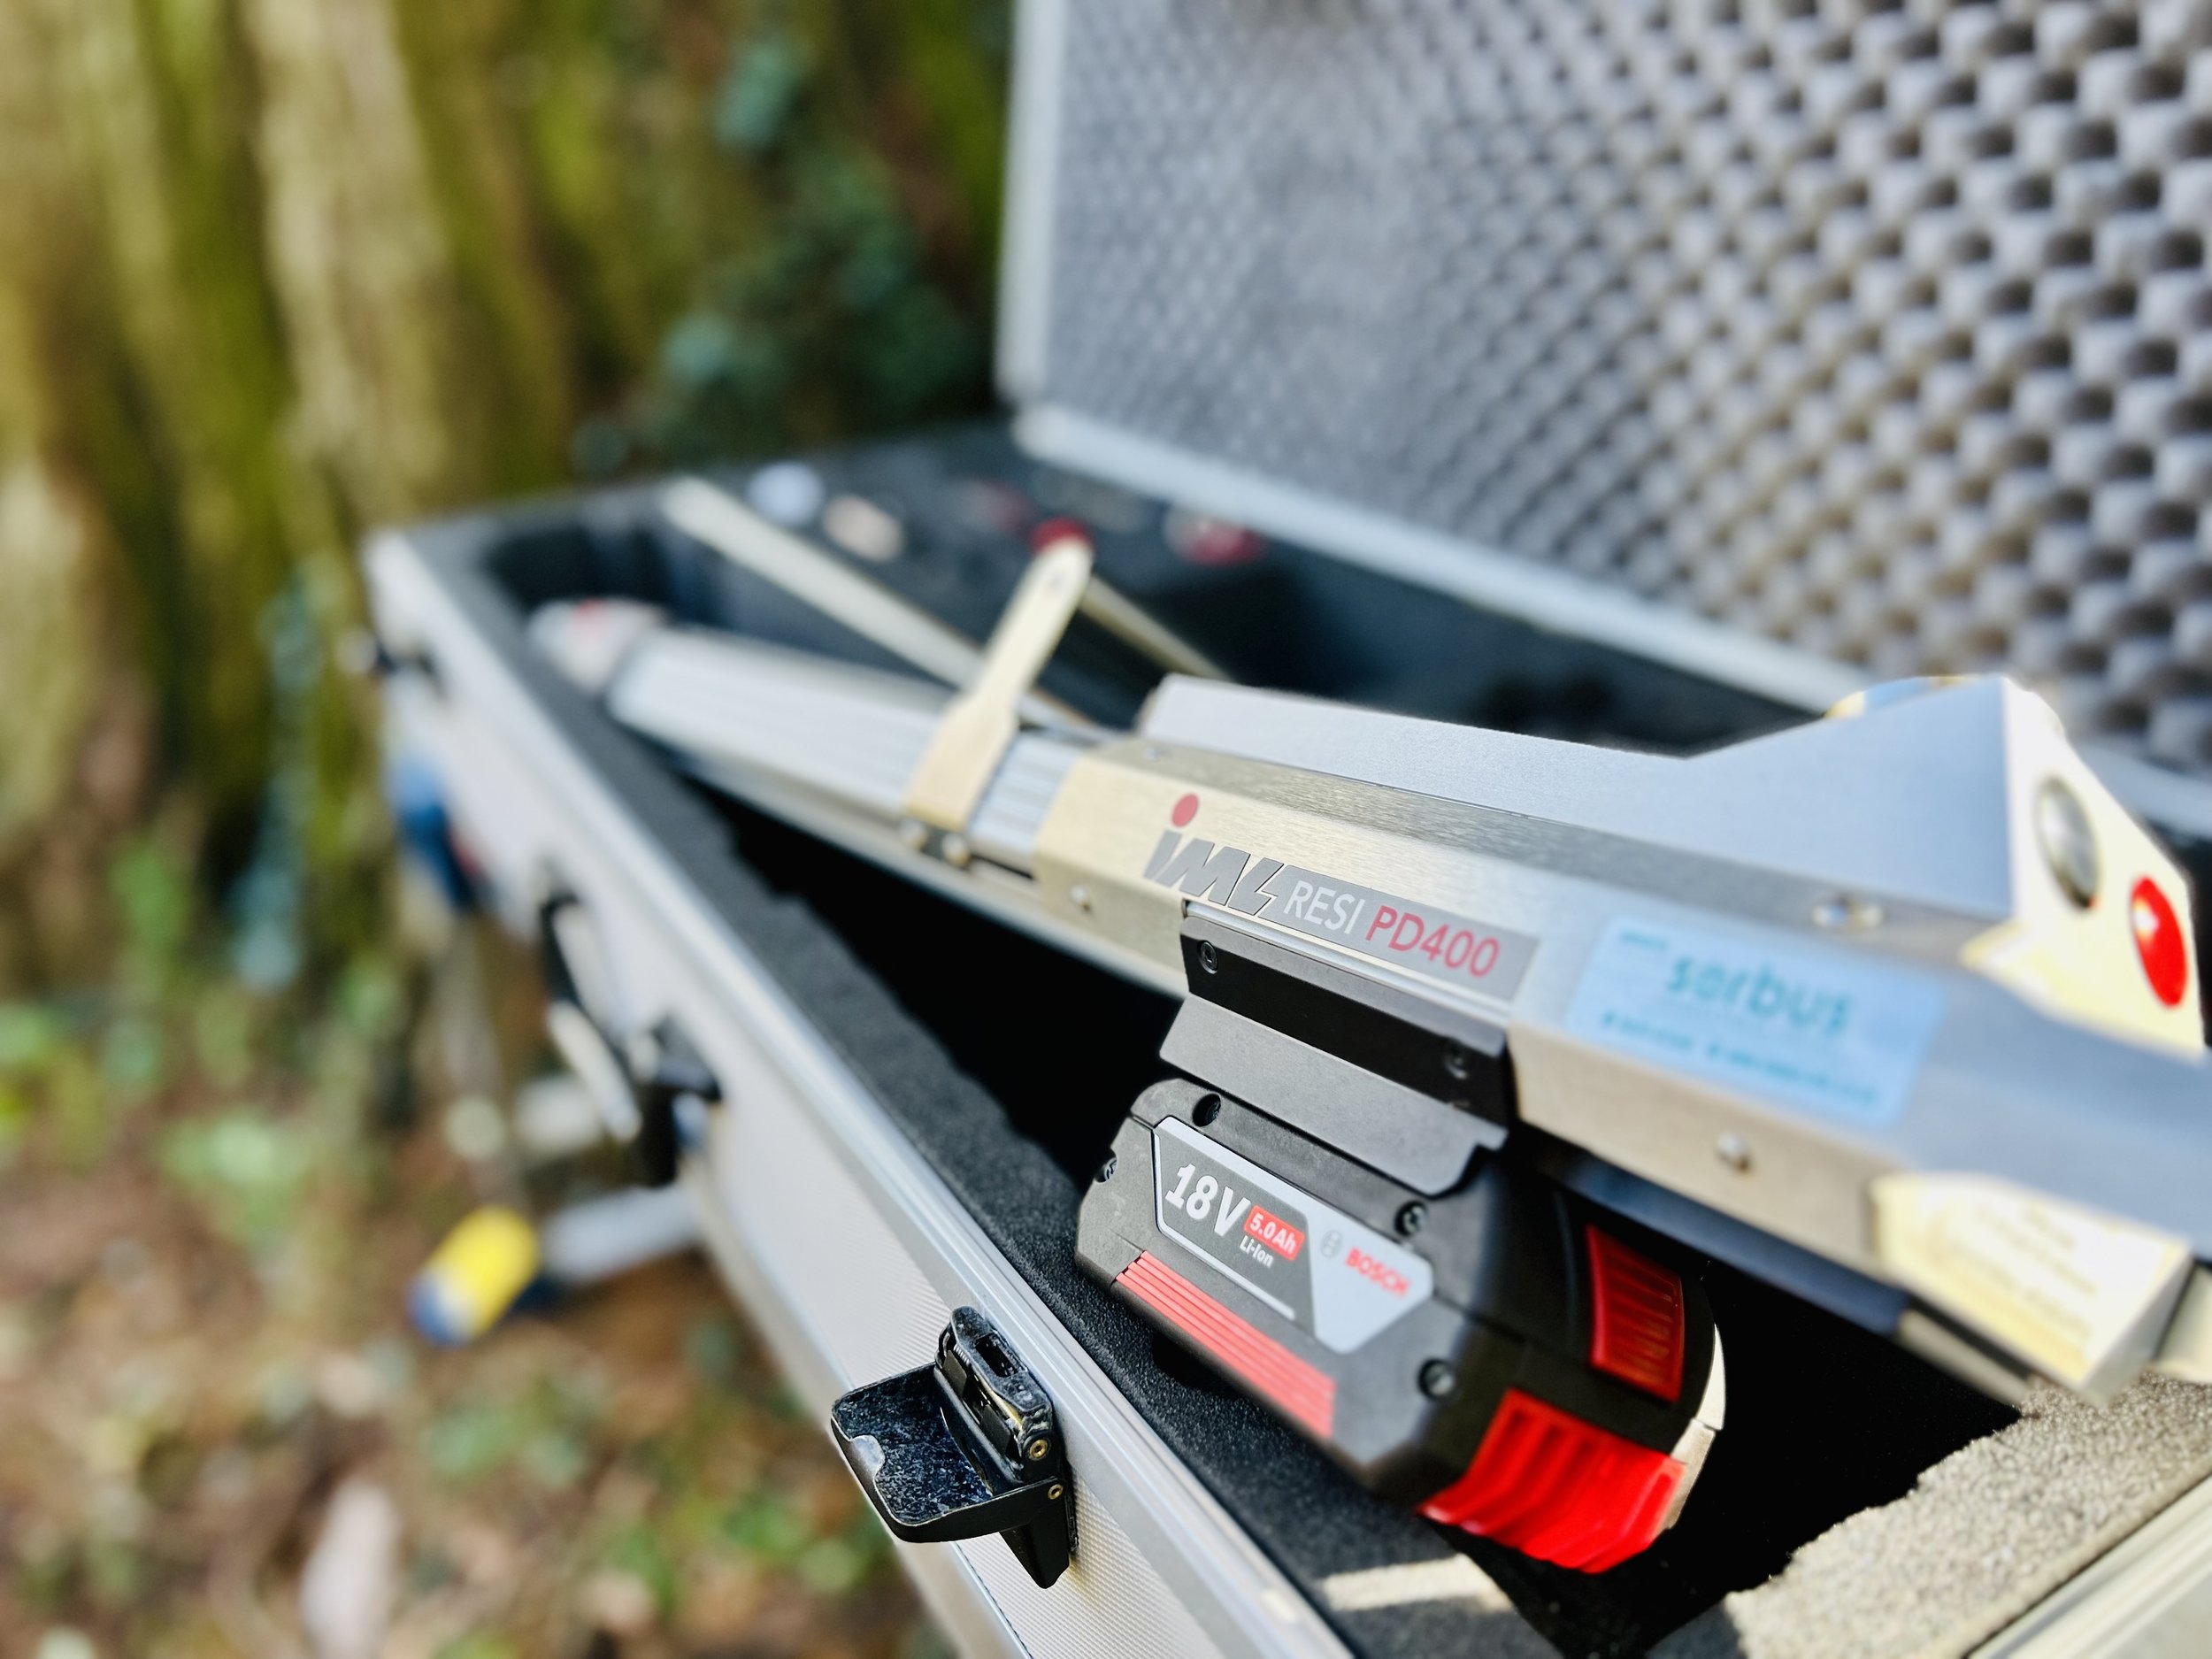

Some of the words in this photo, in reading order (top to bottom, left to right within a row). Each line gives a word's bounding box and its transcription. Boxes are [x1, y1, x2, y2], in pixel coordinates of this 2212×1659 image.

[1283, 880, 1365, 934] RESI
[1365, 905, 1501, 979] PD400
[1165, 1164, 1251, 1237] 18V
[1240, 1235, 1274, 1268] Li-Ion
[1346, 1248, 1409, 1296] BOSCH
